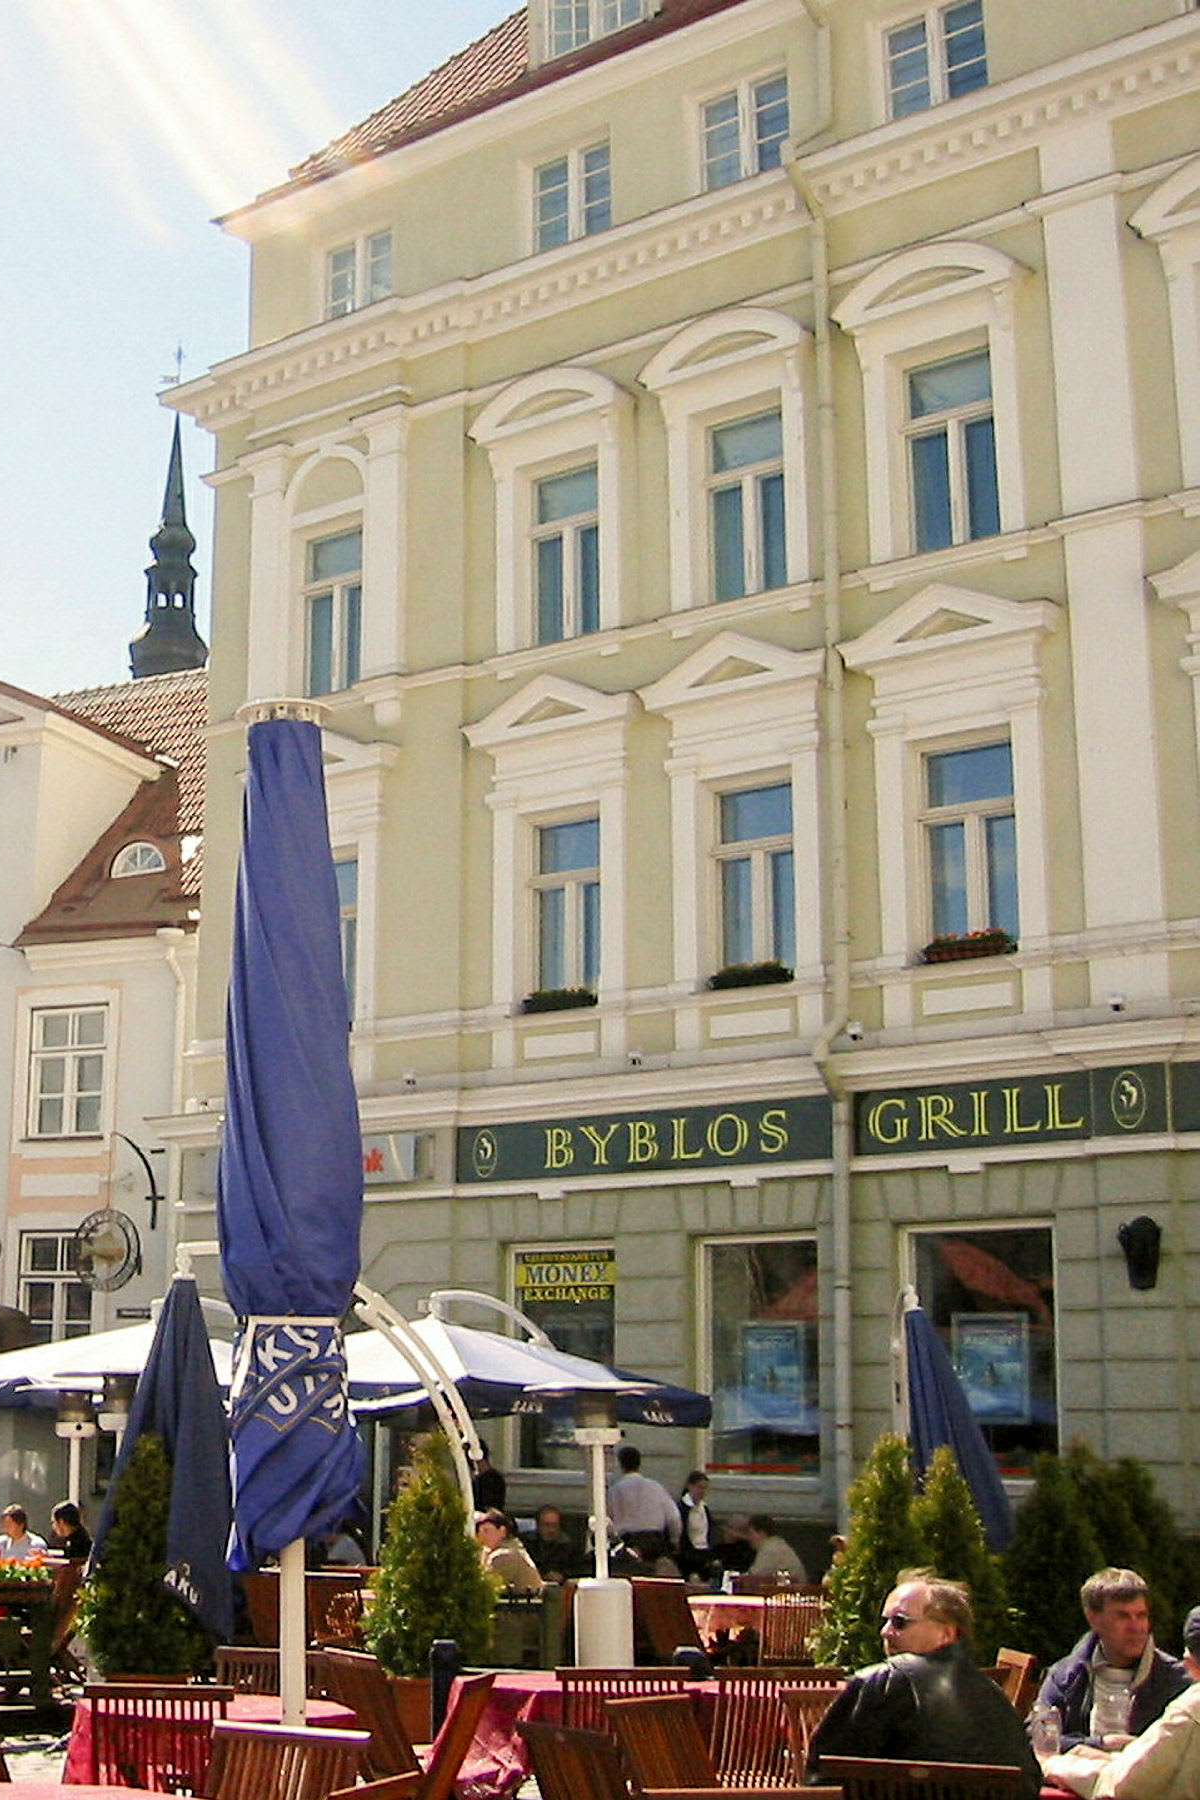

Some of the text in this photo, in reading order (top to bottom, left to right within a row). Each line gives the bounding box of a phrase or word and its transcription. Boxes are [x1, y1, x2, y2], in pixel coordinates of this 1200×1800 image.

[867, 1083, 1084, 1144] GRILL
[544, 1109, 790, 1169] BYBLOS
[526, 1264, 607, 1284] MONEY
[524, 1286, 611, 1301] EXCHANGE
[162, 1569, 199, 1605] AKU
